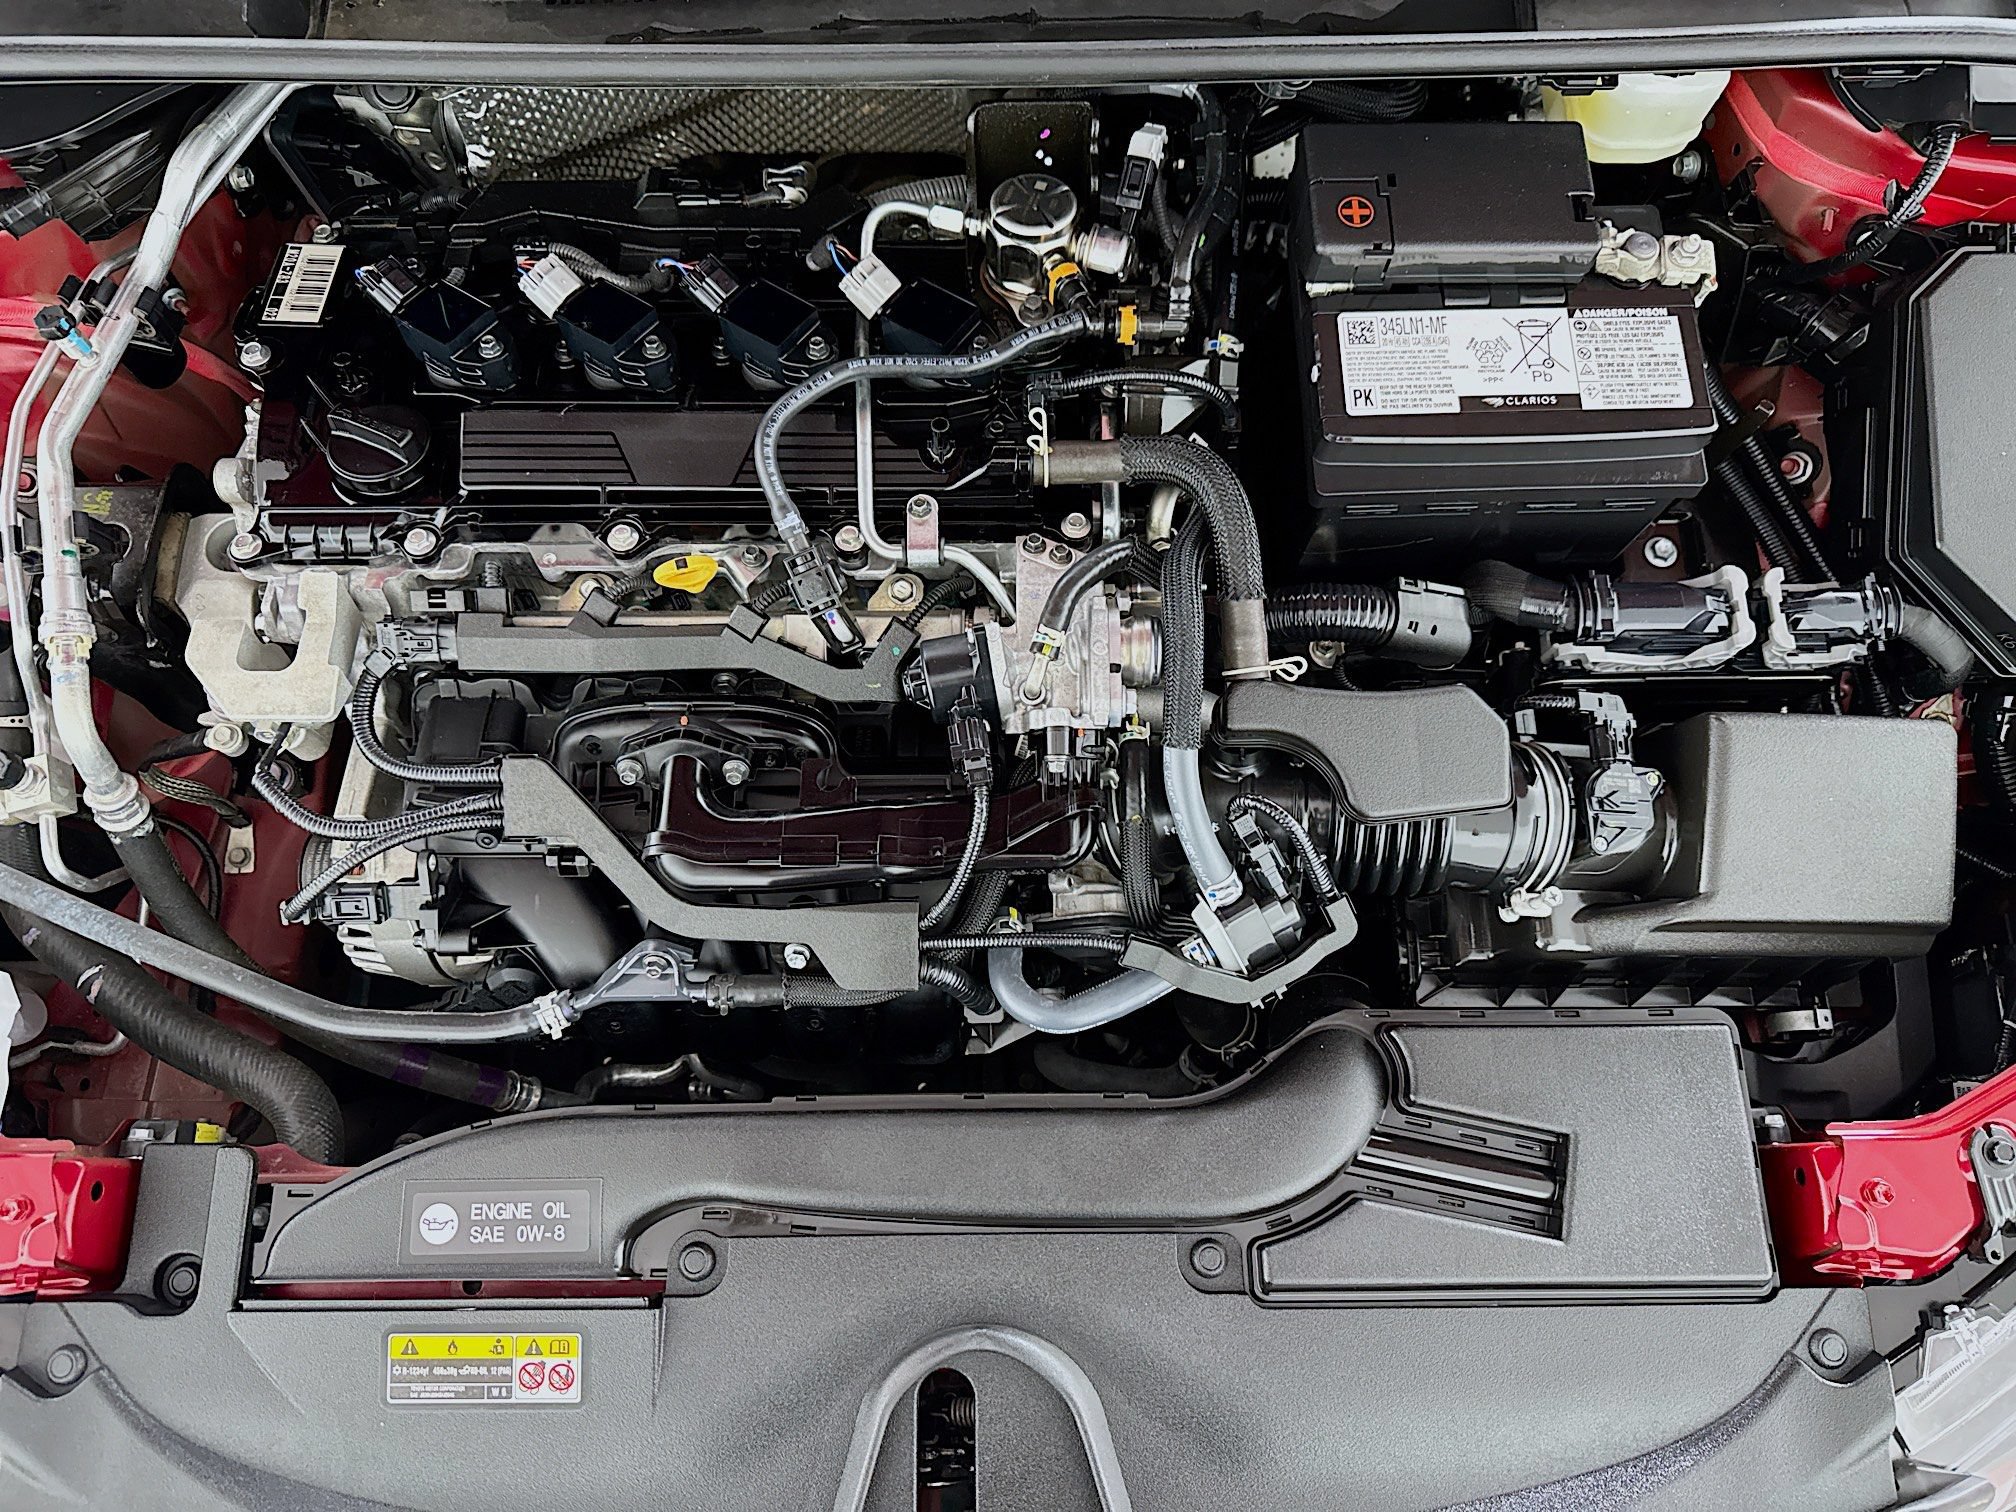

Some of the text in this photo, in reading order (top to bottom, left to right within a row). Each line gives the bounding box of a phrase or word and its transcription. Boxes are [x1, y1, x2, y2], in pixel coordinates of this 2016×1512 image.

[1582, 307, 1668, 317] DANGER/POISON
[1380, 316, 1447, 335] 345LN1-MF
[1532, 370, 1553, 382] Pb
[1353, 389, 1374, 407] PK
[1506, 396, 1558, 405] CLARIOS
[470, 1202, 570, 1220] ENGINE OIL
[469, 1224, 566, 1243] SAE 0W-8
